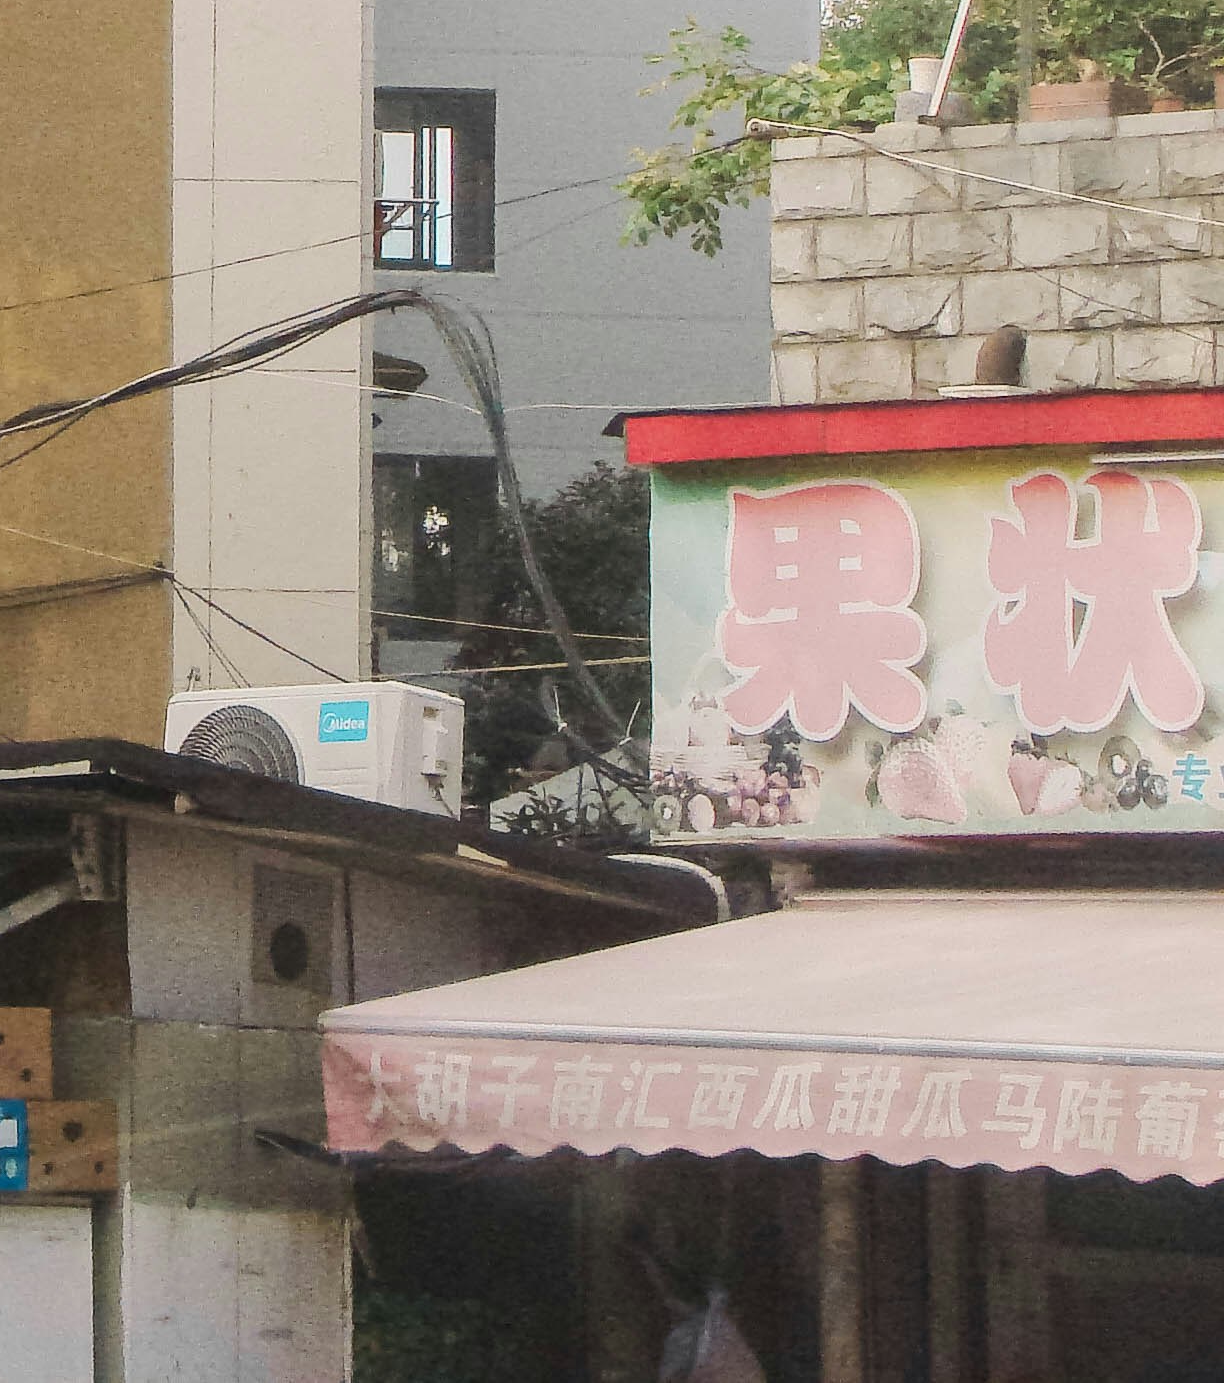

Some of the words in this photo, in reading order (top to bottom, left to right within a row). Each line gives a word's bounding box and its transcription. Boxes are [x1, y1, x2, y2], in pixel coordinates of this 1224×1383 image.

[718, 470, 1205, 741] 果状
[323, 712, 365, 734] Midea
[1172, 752, 1224, 802] 专
[355, 1048, 1224, 1162] 大胡子南汇西瓜甜瓜马陆葡
